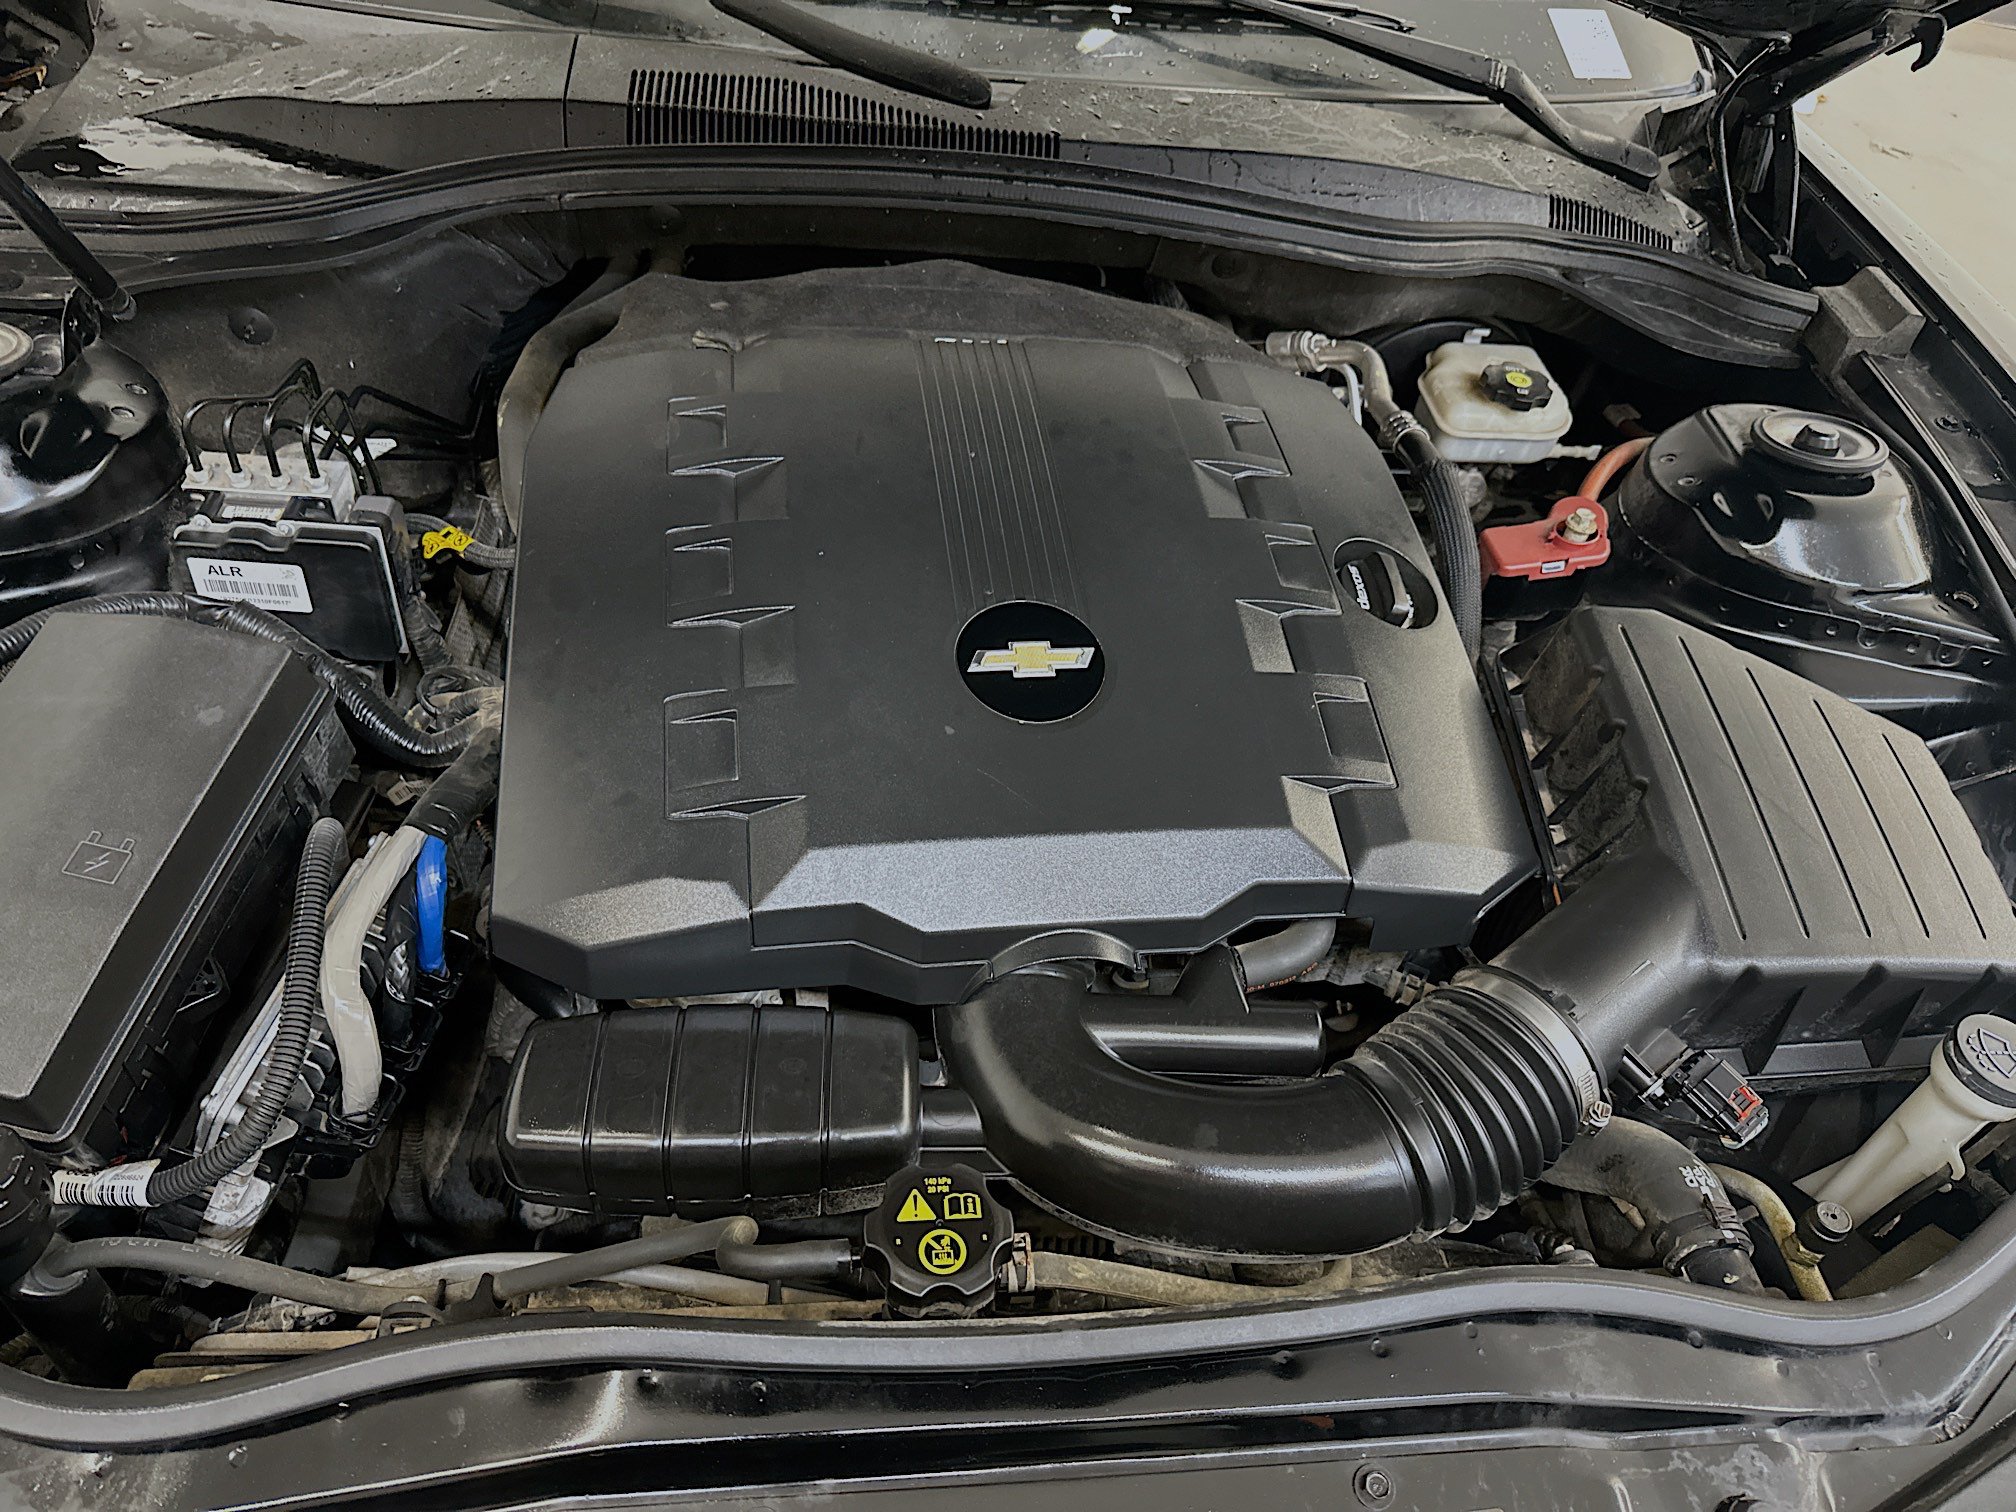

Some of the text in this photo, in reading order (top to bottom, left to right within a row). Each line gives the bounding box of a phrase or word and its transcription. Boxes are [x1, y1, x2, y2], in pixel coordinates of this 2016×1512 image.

[208, 565, 243, 577] ALR
[1347, 564, 1371, 610] dexos
[924, 1177, 952, 1185] 140 kPa
[937, 1185, 950, 1193] PSI
